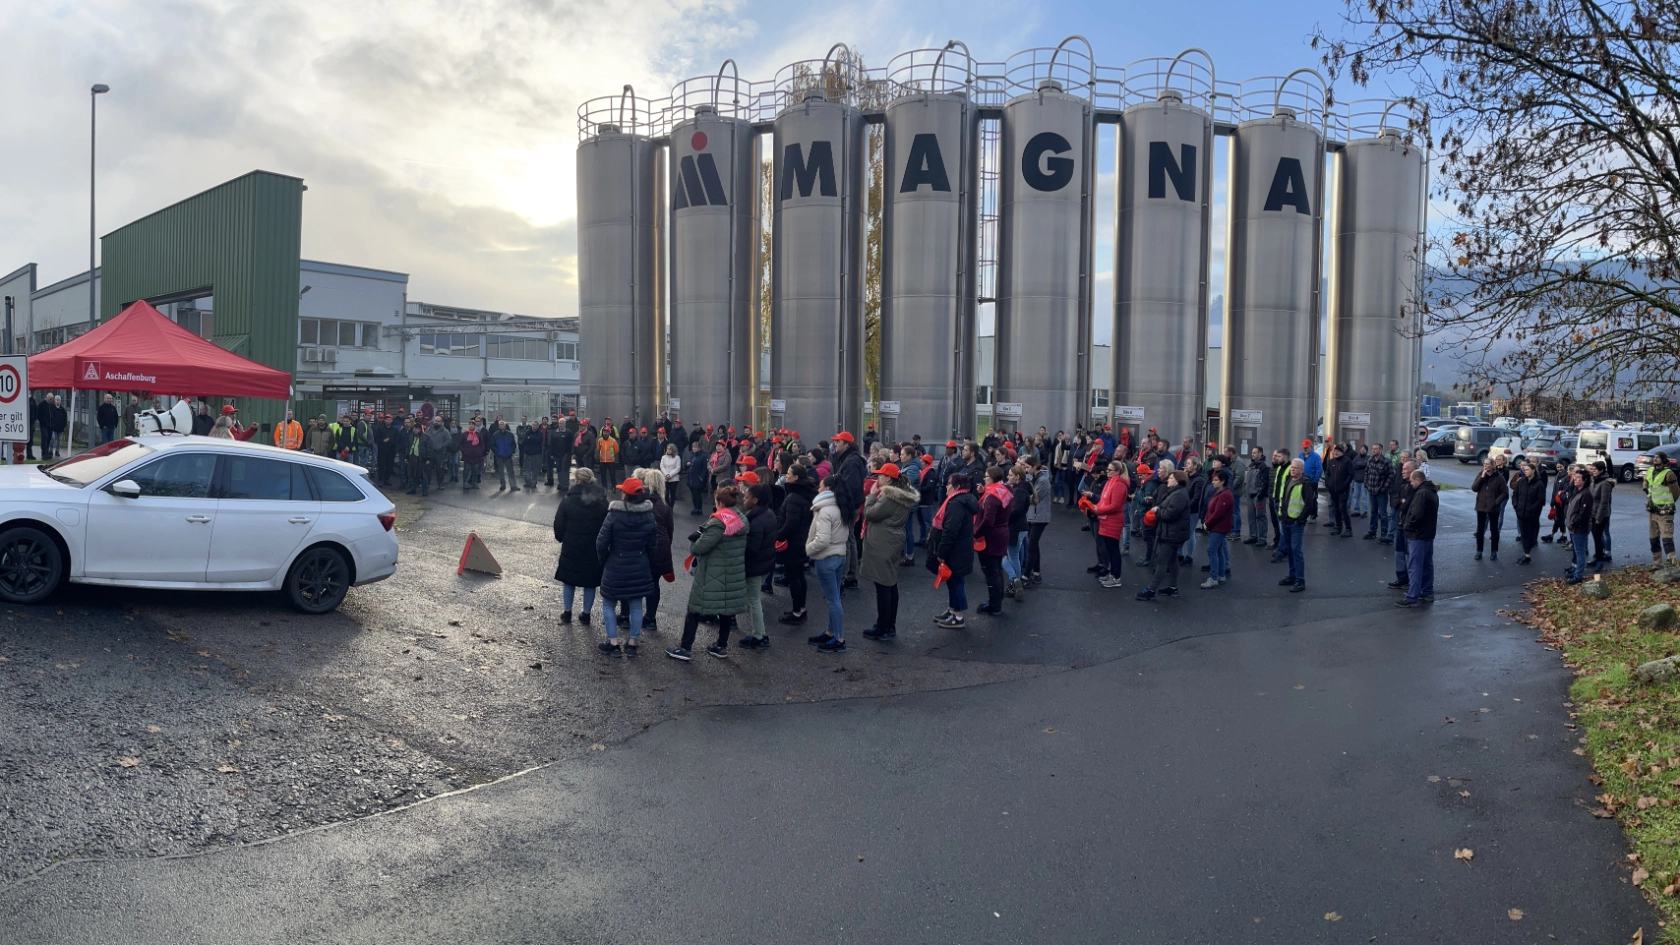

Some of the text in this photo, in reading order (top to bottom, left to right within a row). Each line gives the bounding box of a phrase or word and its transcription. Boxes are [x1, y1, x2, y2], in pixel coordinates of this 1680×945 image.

[781, 131, 1311, 216] MAGNA
[0, 375, 14, 393] 10
[105, 371, 157, 384] Aschaffenburg
[10, 411, 23, 423] gilt
[5, 423, 24, 433] StVO
